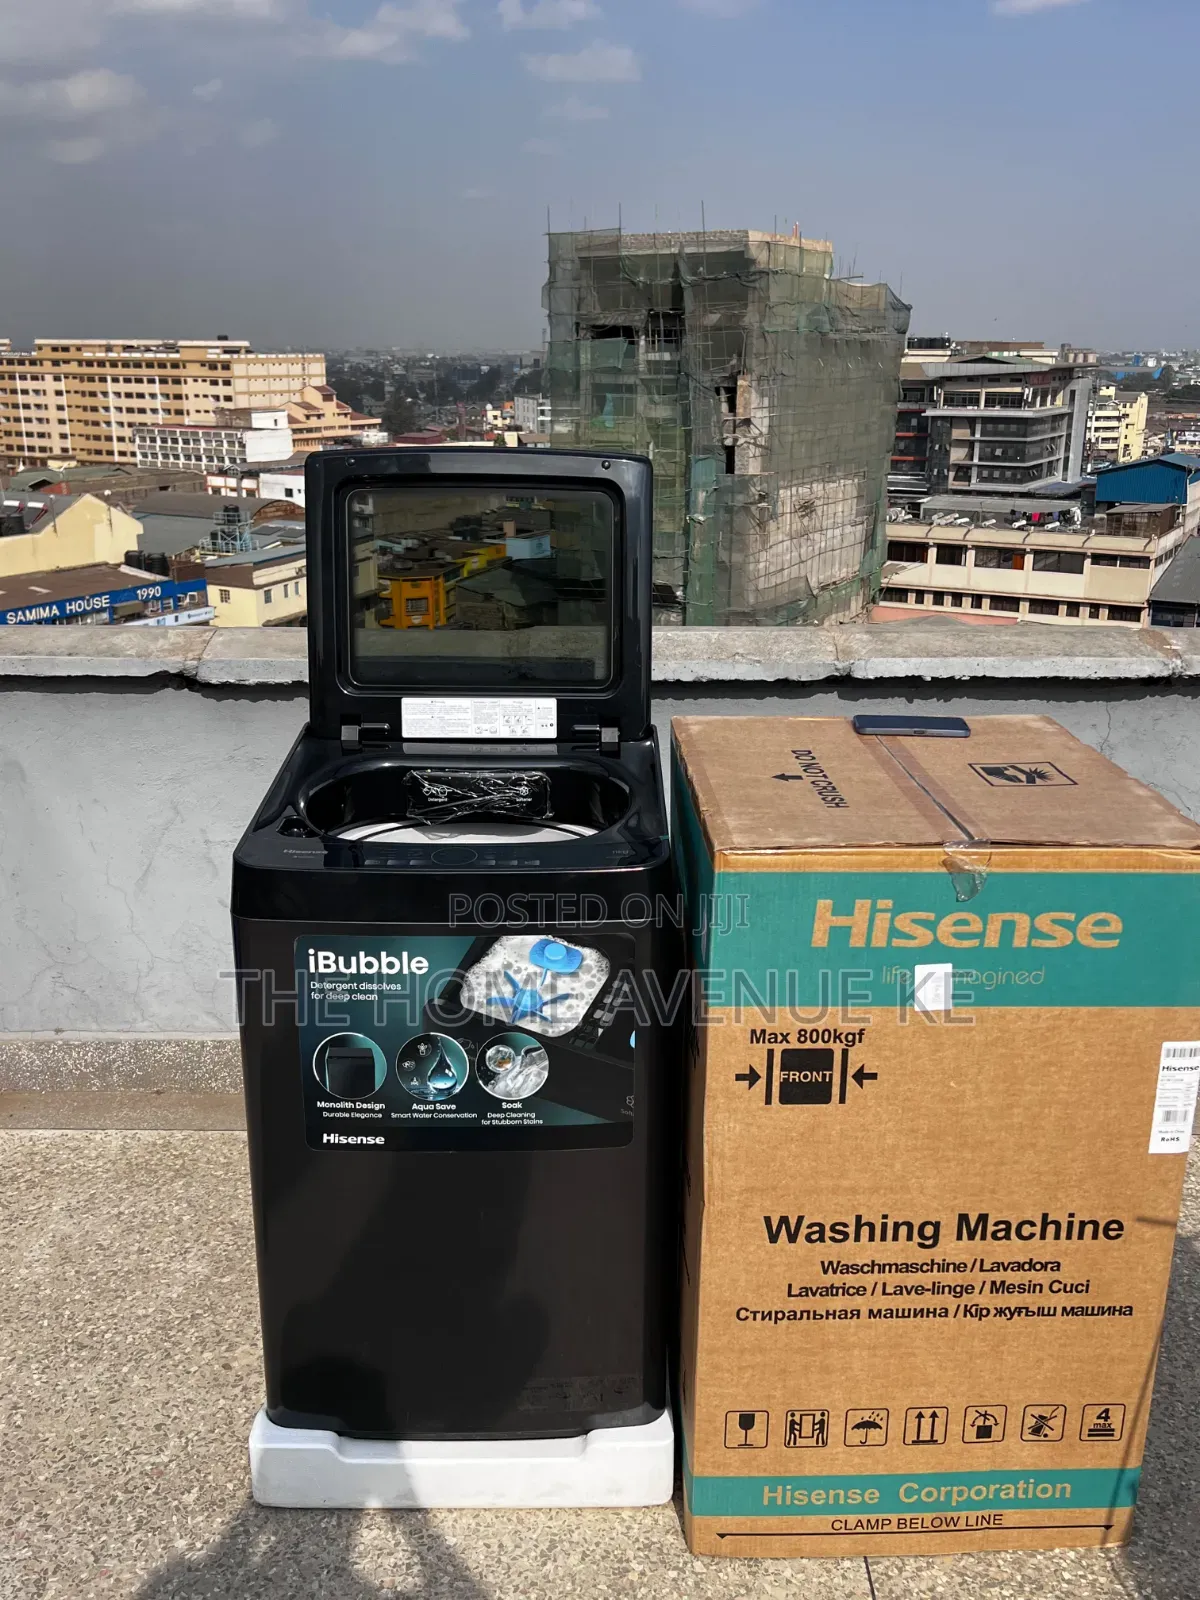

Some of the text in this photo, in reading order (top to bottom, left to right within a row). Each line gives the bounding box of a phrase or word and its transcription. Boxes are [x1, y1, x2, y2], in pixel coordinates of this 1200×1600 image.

[6, 586, 161, 624] SAMIMA HOUSE 1990
[791, 750, 850, 808] DO NOT CRUSH
[811, 899, 1123, 948] Hisense
[308, 948, 429, 975] iBubble
[882, 965, 912, 984] life
[310, 981, 401, 991] Detergent dissolves
[311, 992, 378, 1002] for deep clean
[750, 1028, 866, 1047] Max 800kgf
[1162, 1064, 1200, 1072] Hisense
[780, 1071, 833, 1083] FRONT
[316, 1101, 385, 1110] Monolith Design
[412, 1103, 434, 1111] Aqua
[502, 1101, 522, 1109] Soak
[351, 1111, 382, 1119] Elegance
[506, 1111, 536, 1119] Cleaning
[323, 1133, 385, 1145] Hisense
[763, 1212, 1125, 1249] Washing Machine
[820, 1258, 967, 1275] Waschmaschine
[979, 1258, 1061, 1273] Lavadora
[787, 1282, 867, 1298] Lavatrice
[881, 1281, 975, 1299] Lave-linge
[989, 1280, 1044, 1295] Mesin
[1048, 1279, 1091, 1294] Cuci
[735, 1306, 861, 1324] Стиральная
[867, 1306, 949, 1320] машина
[1061, 1305, 1134, 1317] машина
[1096, 1407, 1110, 1422] 4
[763, 1479, 1072, 1506] Hisense Corporation
[831, 1514, 1003, 1531] CLAMP BELOW LINE
